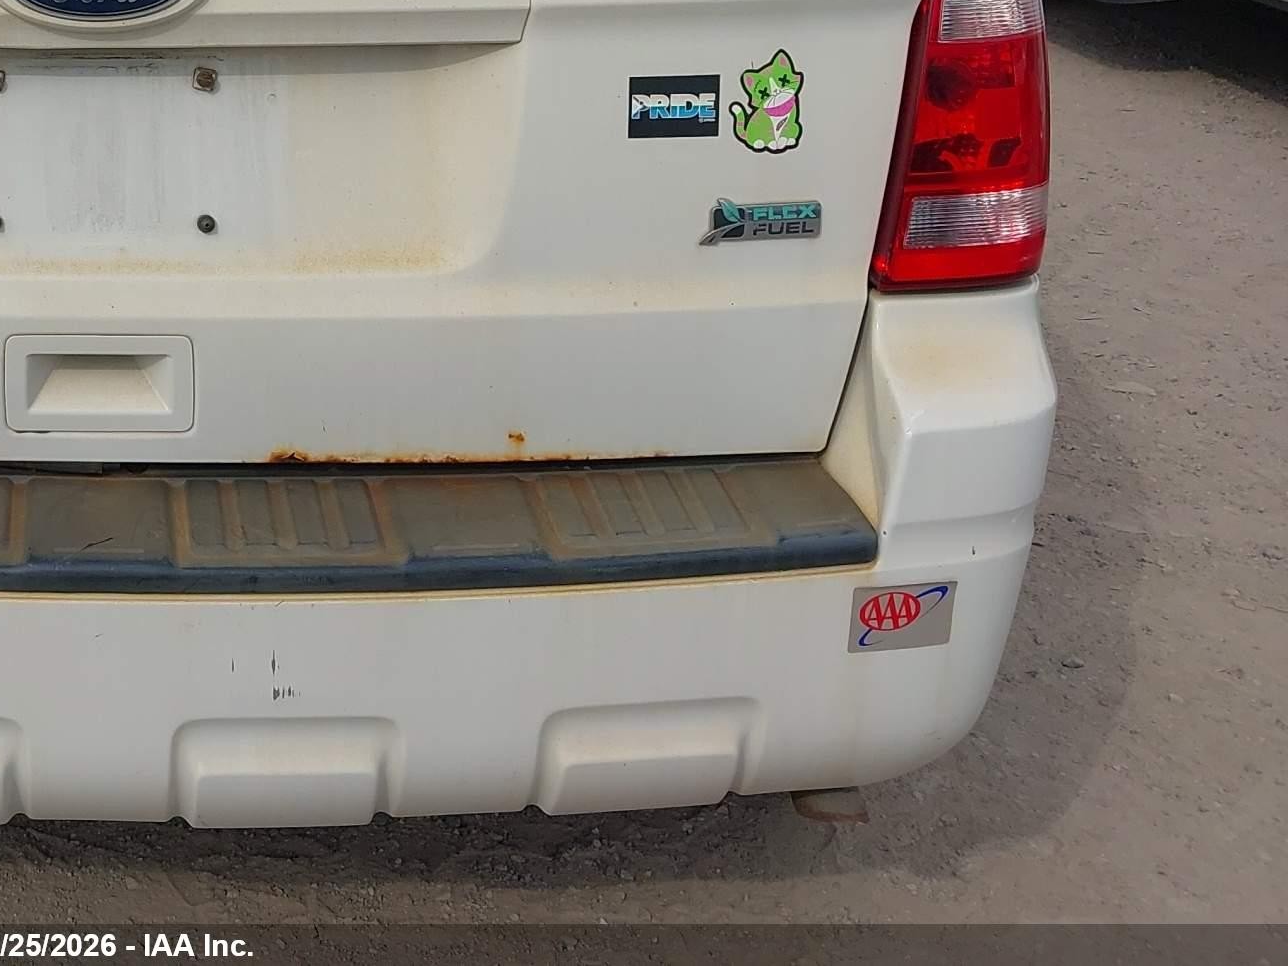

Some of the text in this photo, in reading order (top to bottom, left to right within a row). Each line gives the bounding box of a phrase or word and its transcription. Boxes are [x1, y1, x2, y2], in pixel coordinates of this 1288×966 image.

[631, 93, 716, 120] PRIDE
[753, 202, 817, 220] FLEX
[753, 221, 814, 236] FUEL
[867, 593, 914, 630] AAA
